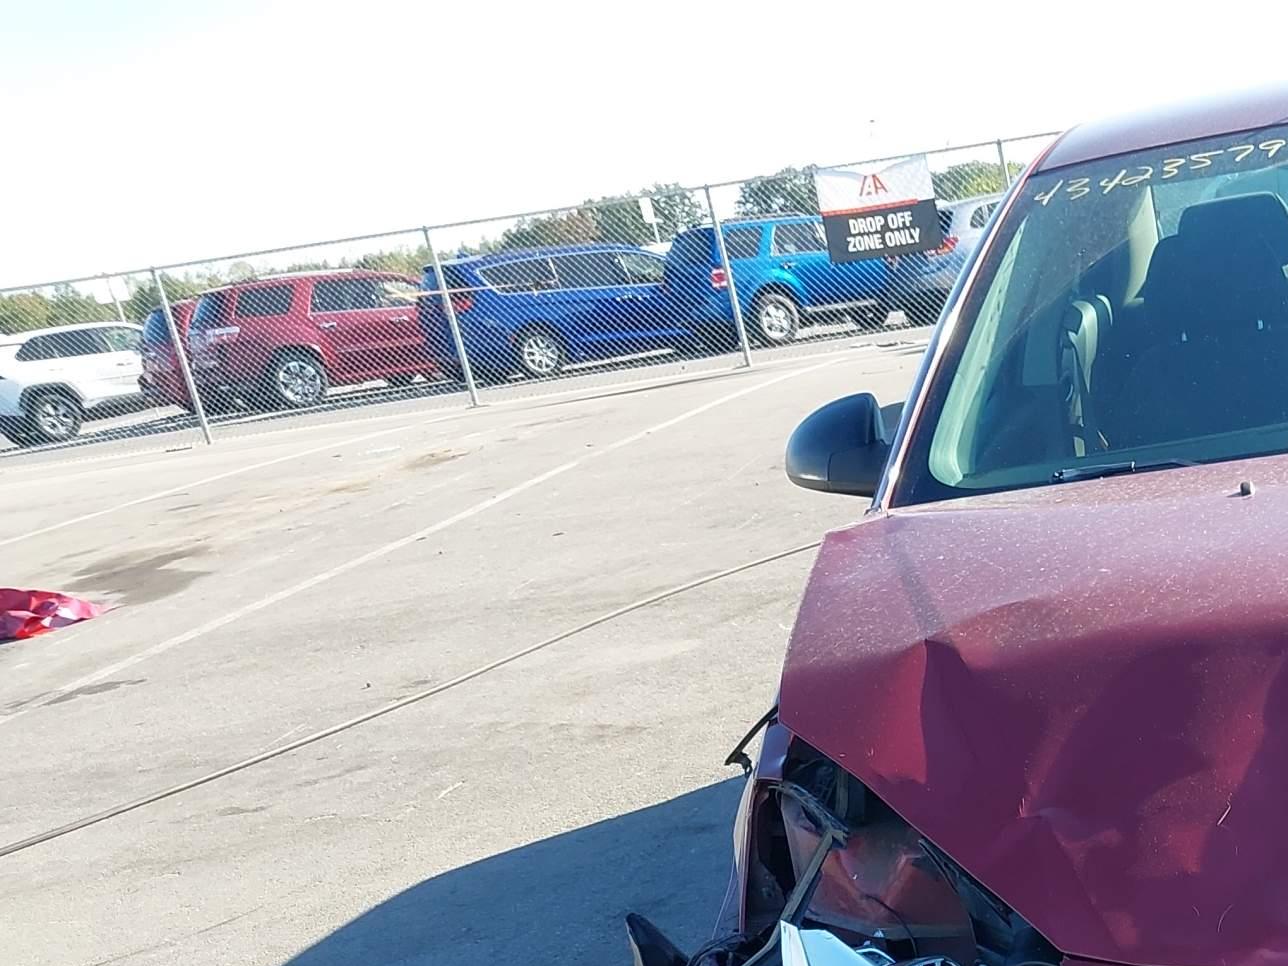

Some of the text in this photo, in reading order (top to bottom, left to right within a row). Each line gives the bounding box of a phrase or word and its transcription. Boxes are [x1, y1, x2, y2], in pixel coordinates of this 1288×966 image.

[1034, 139, 1286, 207] 43423579
[848, 210, 913, 235] DROP OFF
[846, 227, 920, 253] ZONE ONLY
